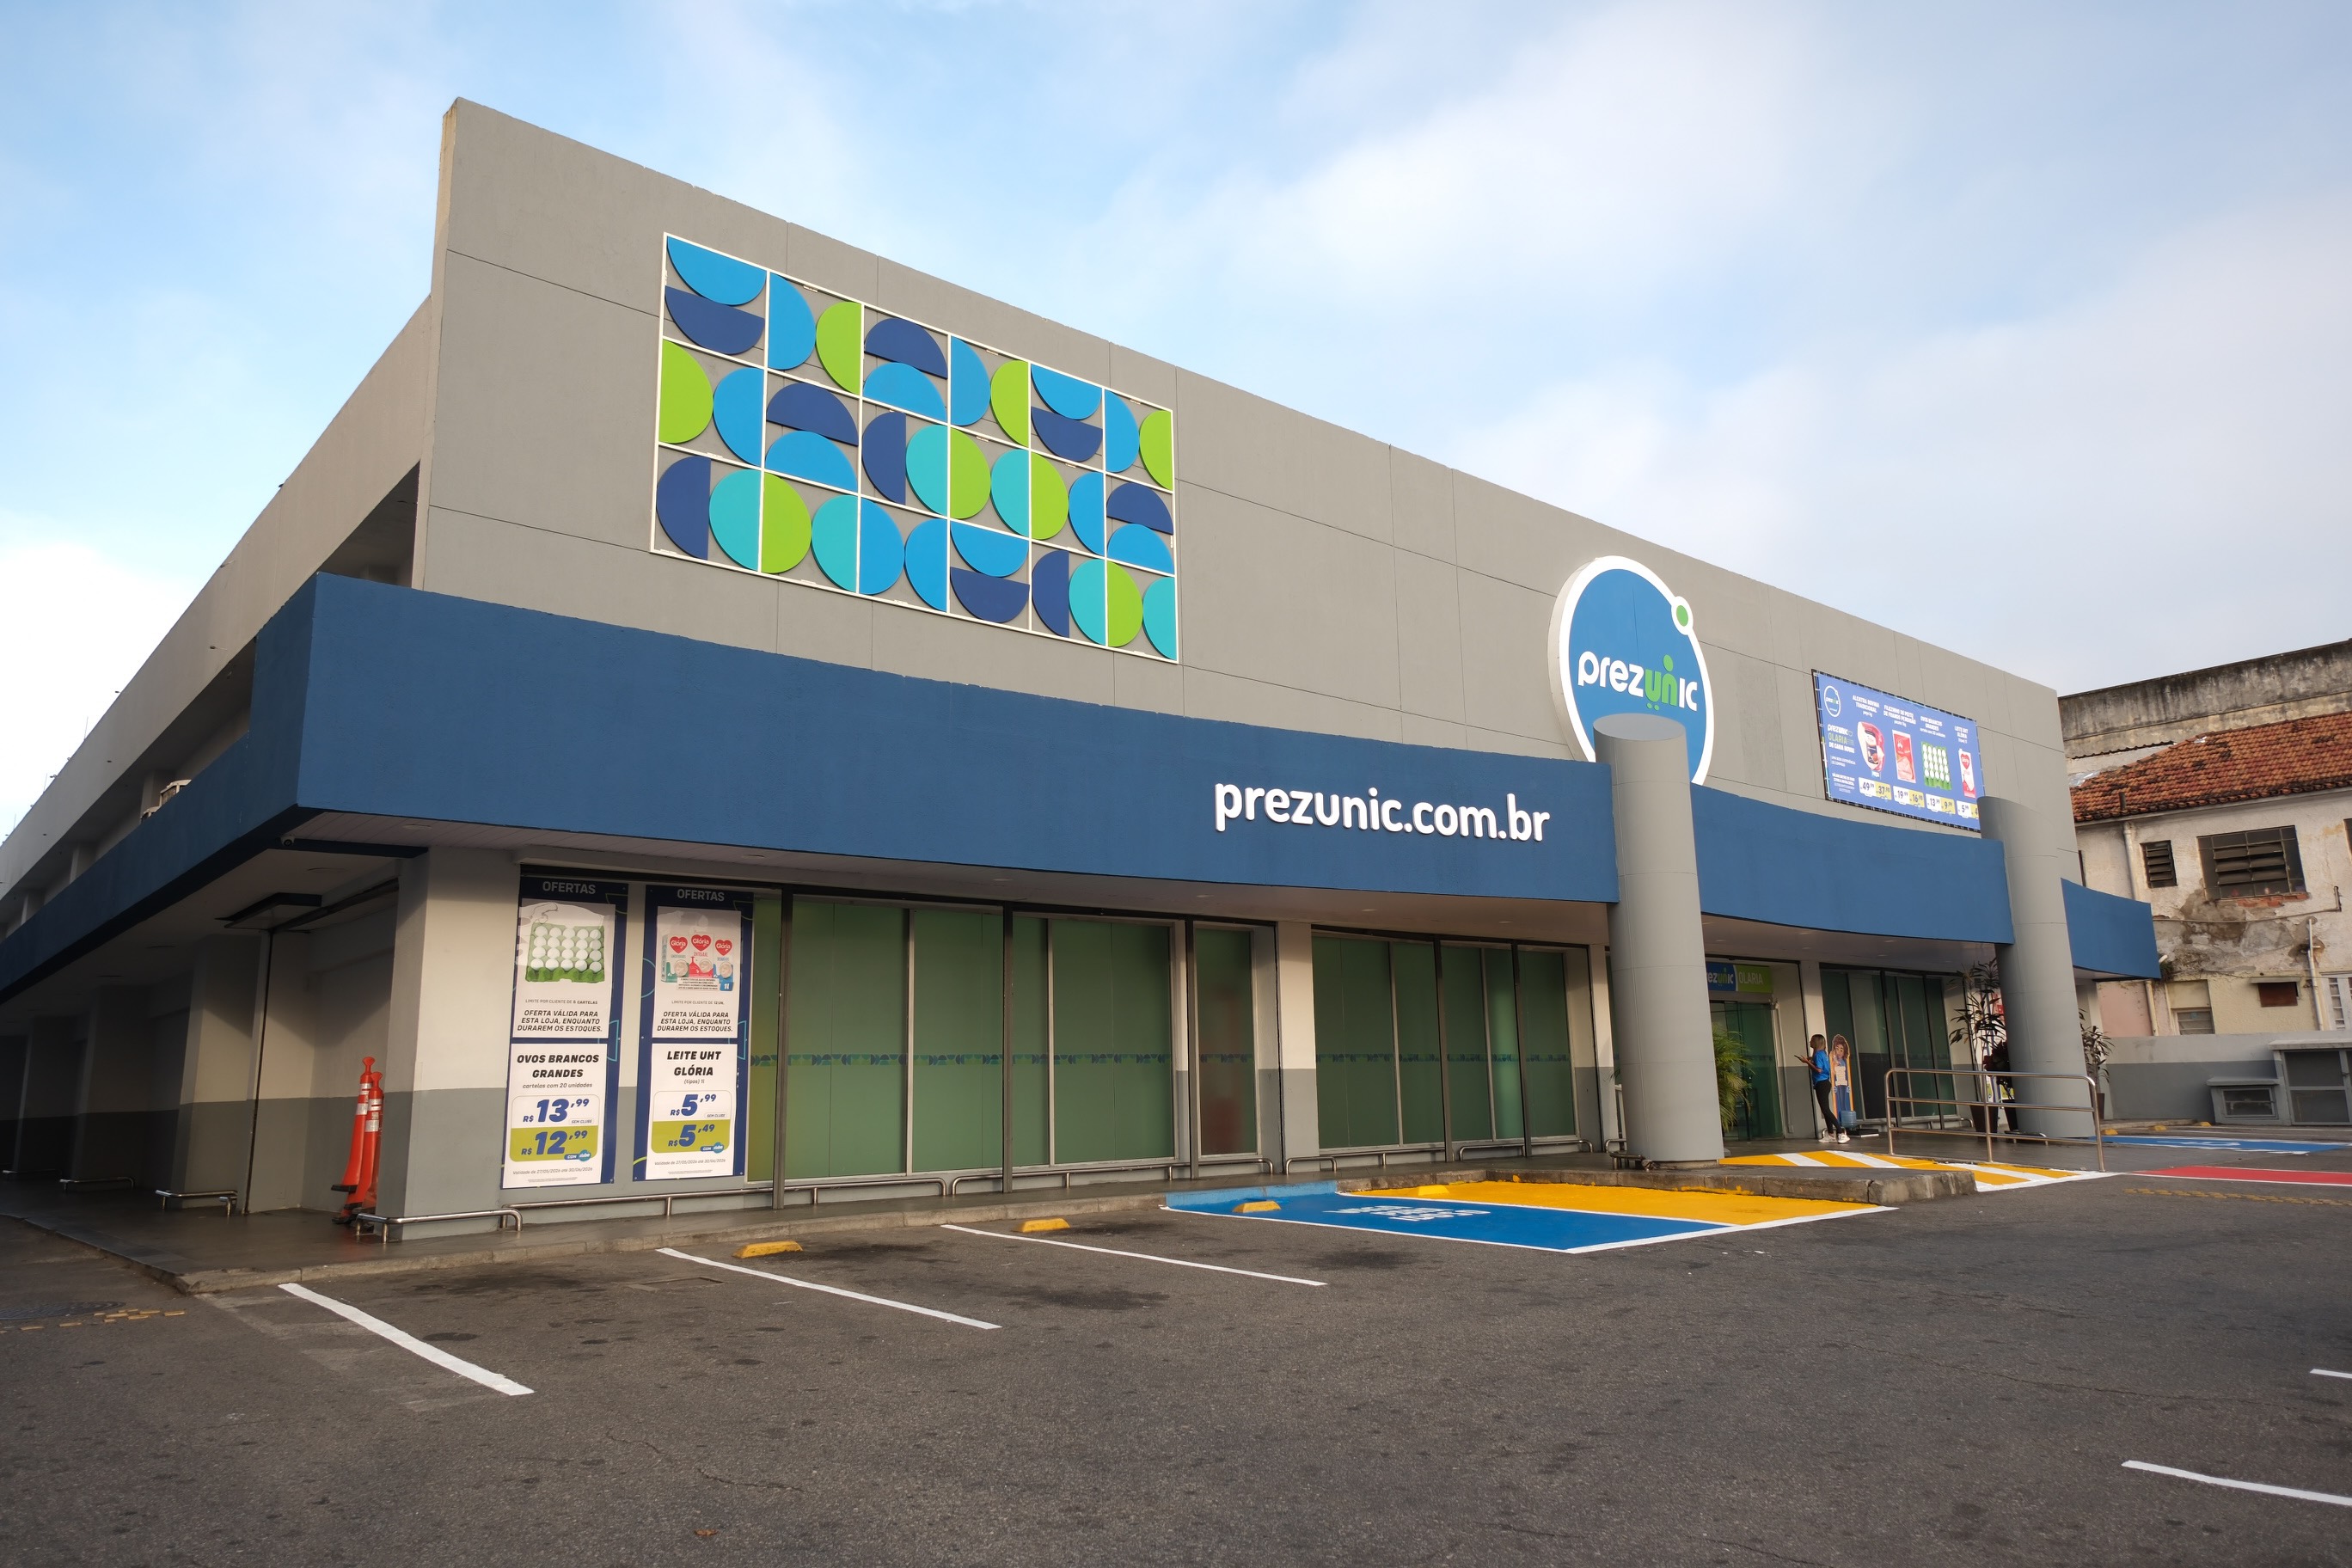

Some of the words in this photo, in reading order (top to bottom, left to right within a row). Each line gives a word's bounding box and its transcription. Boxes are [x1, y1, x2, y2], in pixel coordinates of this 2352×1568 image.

[1577, 650, 1698, 712] prezunic
[1215, 781, 1550, 842] prezunic.com.br
[542, 881, 596, 894] OFERTAS
[677, 889, 725, 901] OFERTAS
[1707, 967, 1733, 986] ezunic
[1739, 972, 1763, 985] OLARIA
[517, 1055, 546, 1063] OVOS
[548, 1054, 599, 1063] BRANCOS
[667, 1051, 697, 1060] LEITE
[700, 1051, 721, 1060] UHT
[532, 1069, 583, 1078] GRANDES
[674, 1064, 713, 1076] GLÓRIA
[537, 1099, 589, 1122] 13,99
[681, 1094, 716, 1116] 5,99
[535, 1130, 588, 1155] 12,99
[679, 1124, 715, 1147] 5,49
